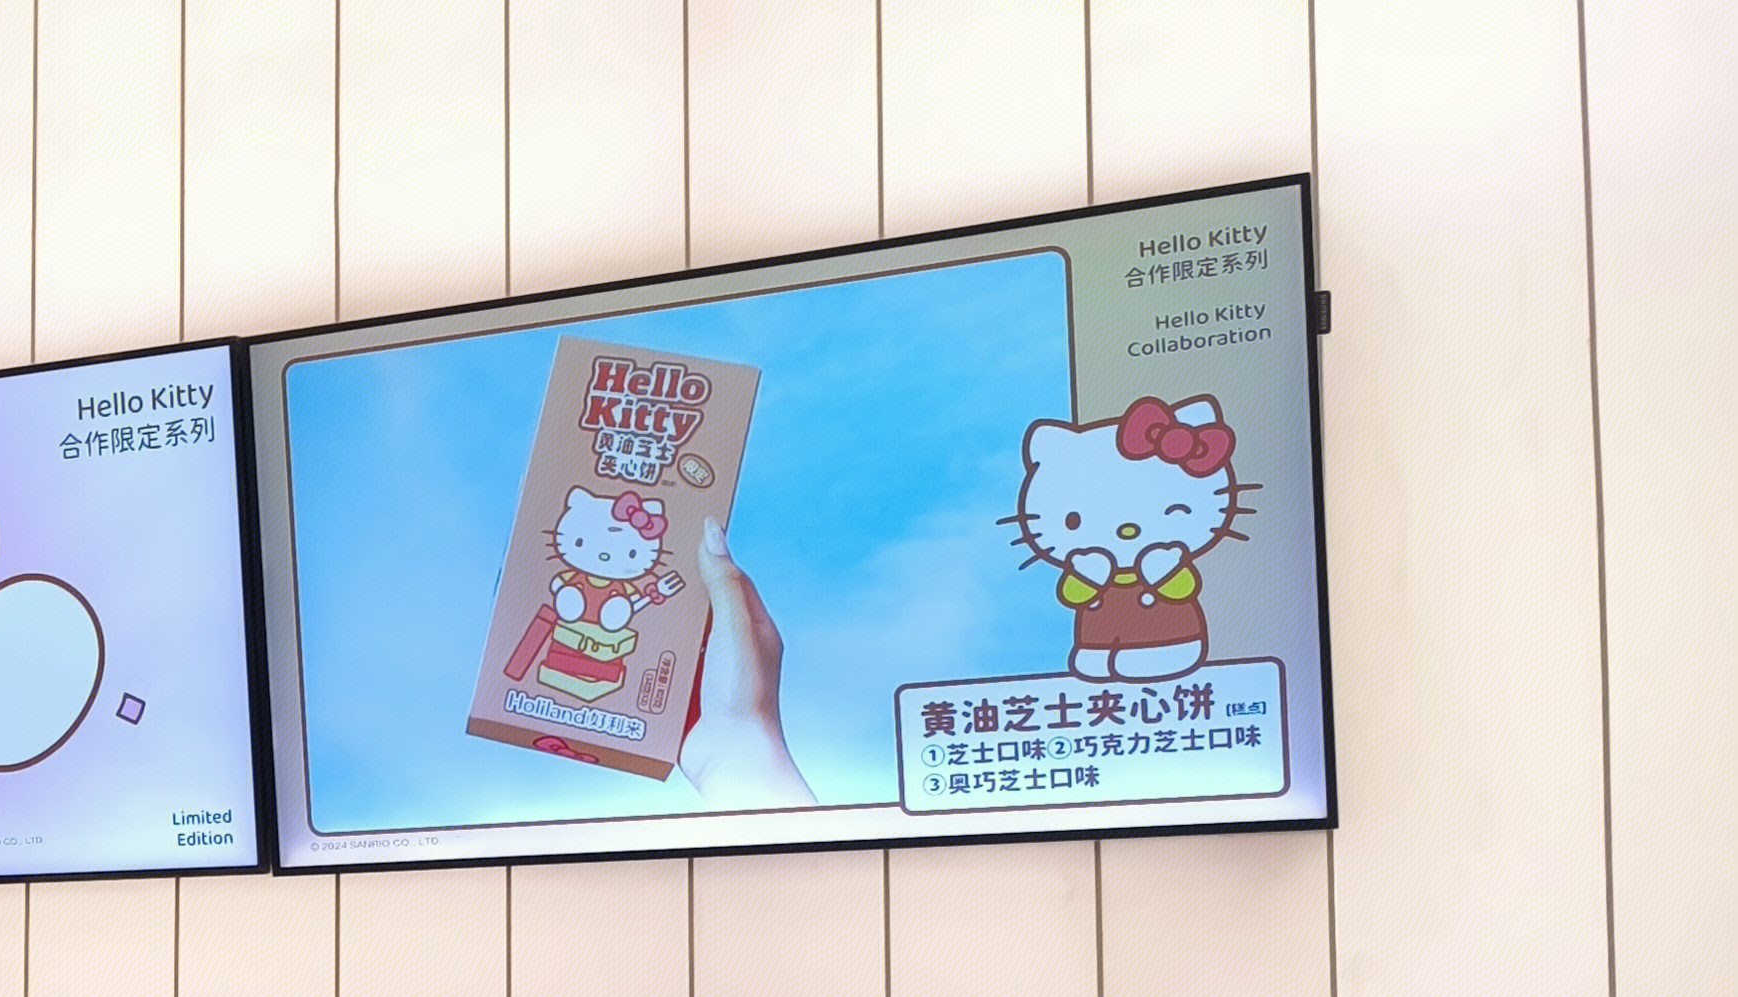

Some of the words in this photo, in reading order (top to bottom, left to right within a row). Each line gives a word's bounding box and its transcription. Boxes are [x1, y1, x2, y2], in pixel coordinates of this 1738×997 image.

[1139, 233, 1201, 258] Hello
[1209, 224, 1268, 248] Kitty
[1124, 248, 1269, 289] 合作限定系列
[1155, 310, 1209, 330] Hello
[1215, 303, 1266, 323] Kitty
[1127, 326, 1272, 357] Collaboration
[592, 360, 707, 402] Hello
[77, 391, 144, 420] Hello
[151, 384, 214, 410] Kitty
[584, 395, 698, 443] Kitty
[59, 415, 215, 459] 合作限定系列
[507, 690, 588, 725] Holiland
[588, 711, 643, 738] 好利来
[921, 683, 1215, 738] 黄油芝士夹心饼
[172, 809, 232, 826] Limited
[177, 831, 234, 847] Edition
[322, 841, 347, 851] 2024
